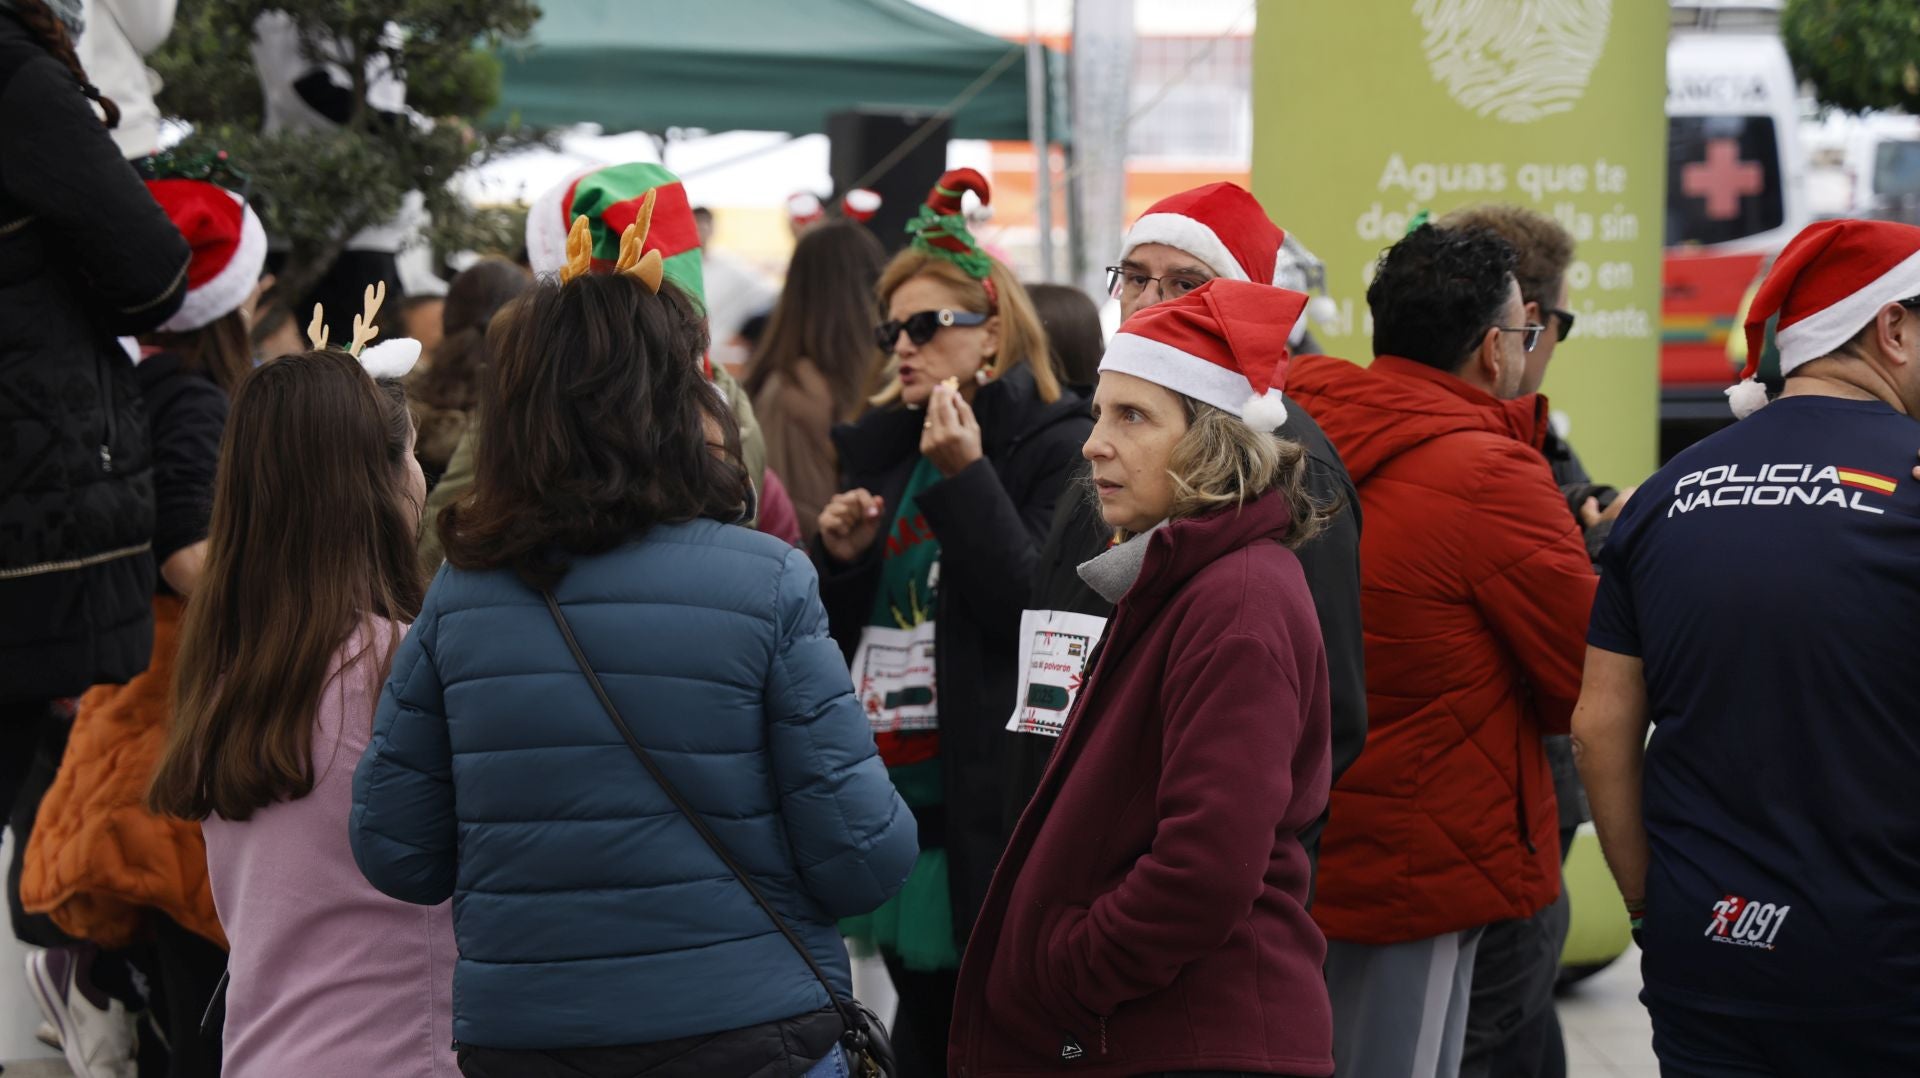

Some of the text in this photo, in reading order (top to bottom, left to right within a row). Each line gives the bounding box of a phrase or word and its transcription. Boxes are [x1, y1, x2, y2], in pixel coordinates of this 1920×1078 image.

[1378, 152, 1628, 202] Aguas que te
[1601, 203, 1639, 241] sin
[1597, 261, 1634, 290] en
[1667, 486, 1885, 518] NACIONAL
[1731, 900, 1791, 943] 091
